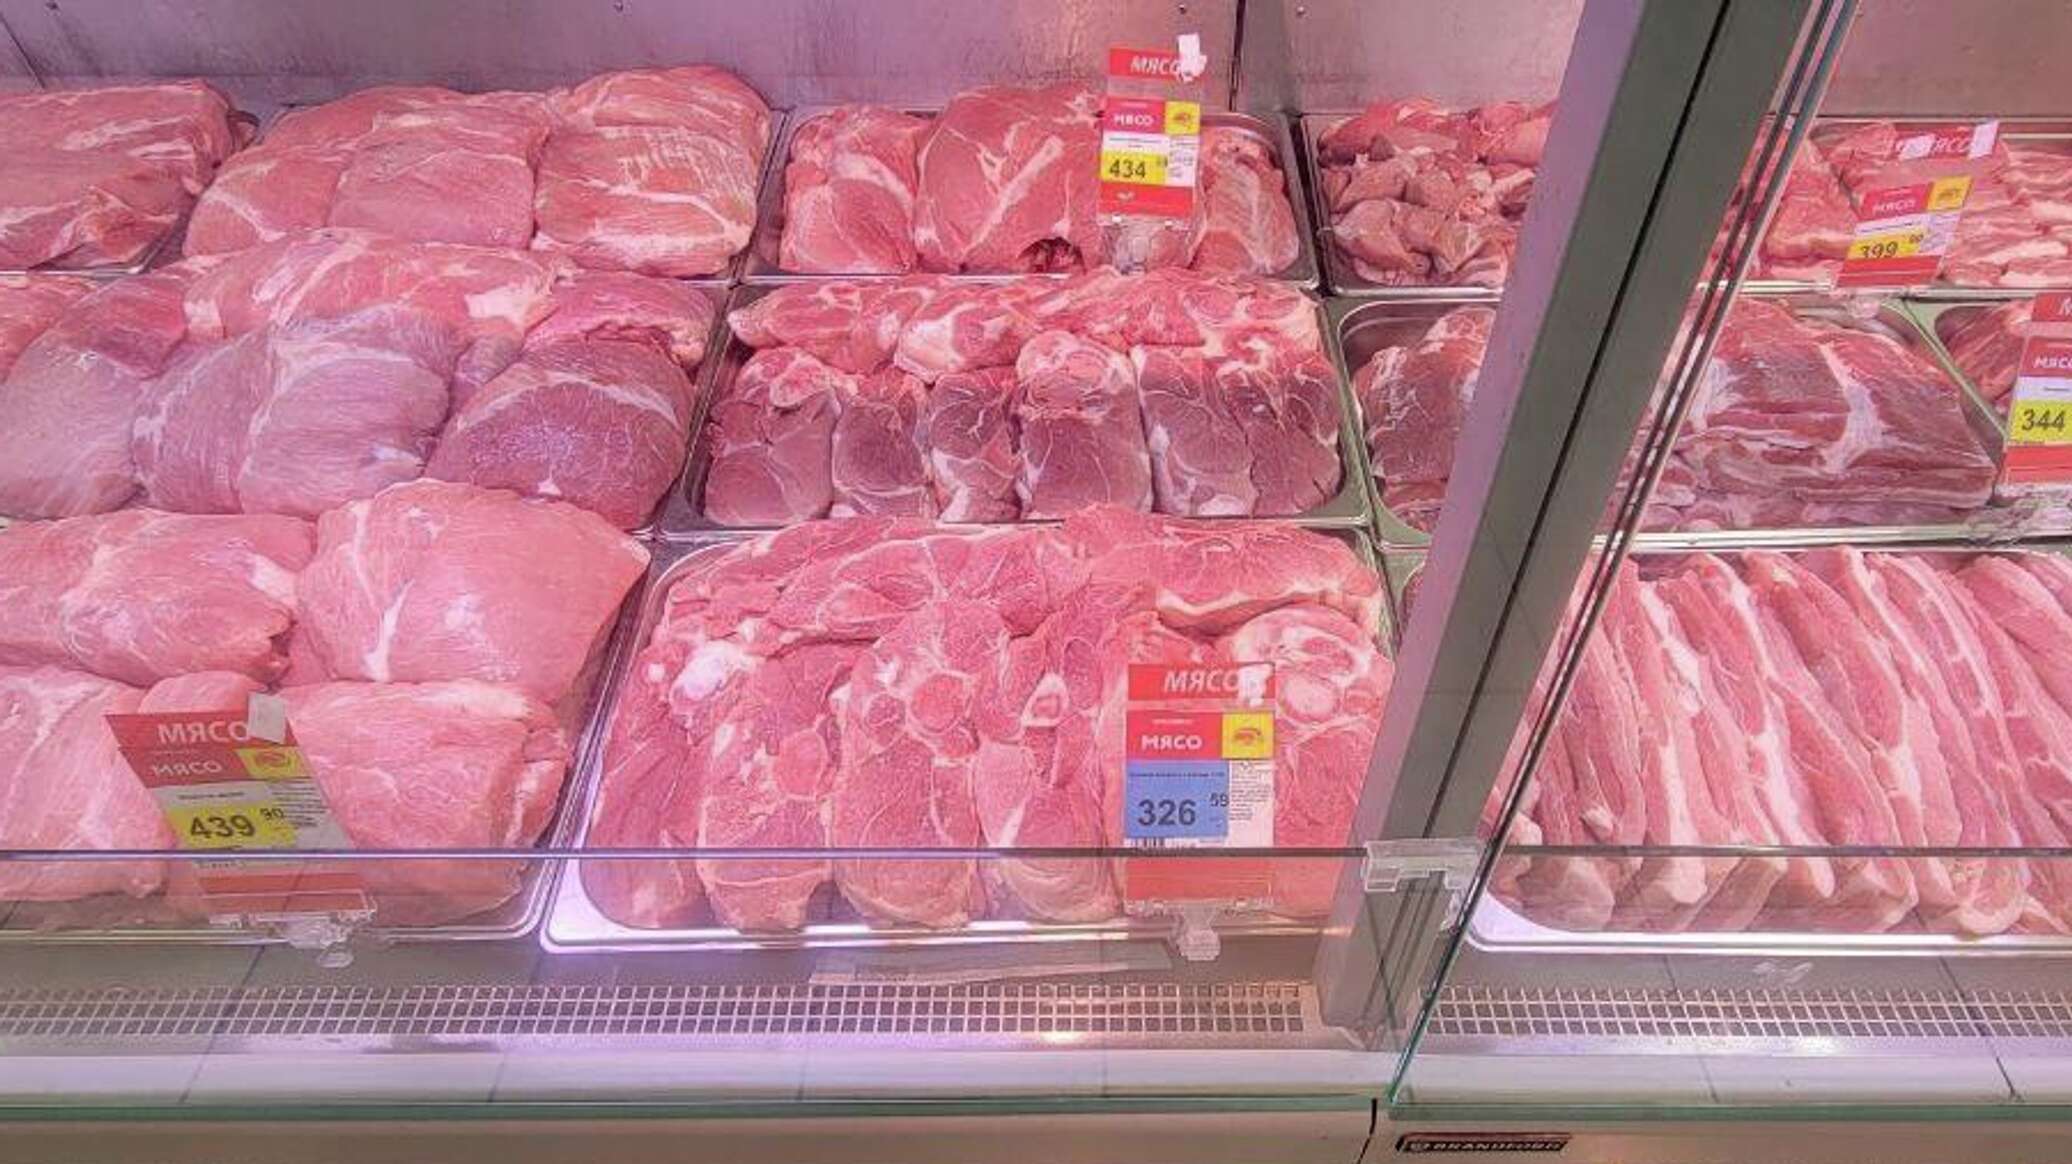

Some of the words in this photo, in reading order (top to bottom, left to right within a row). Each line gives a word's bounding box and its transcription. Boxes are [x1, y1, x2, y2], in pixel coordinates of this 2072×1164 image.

[1109, 158, 1146, 178] 434
[2021, 408, 2066, 432] 344
[1141, 734, 1203, 750] МЯСО
[151, 759, 224, 776] МЯСО
[1138, 798, 1197, 827] 326
[190, 814, 256, 839] 439
